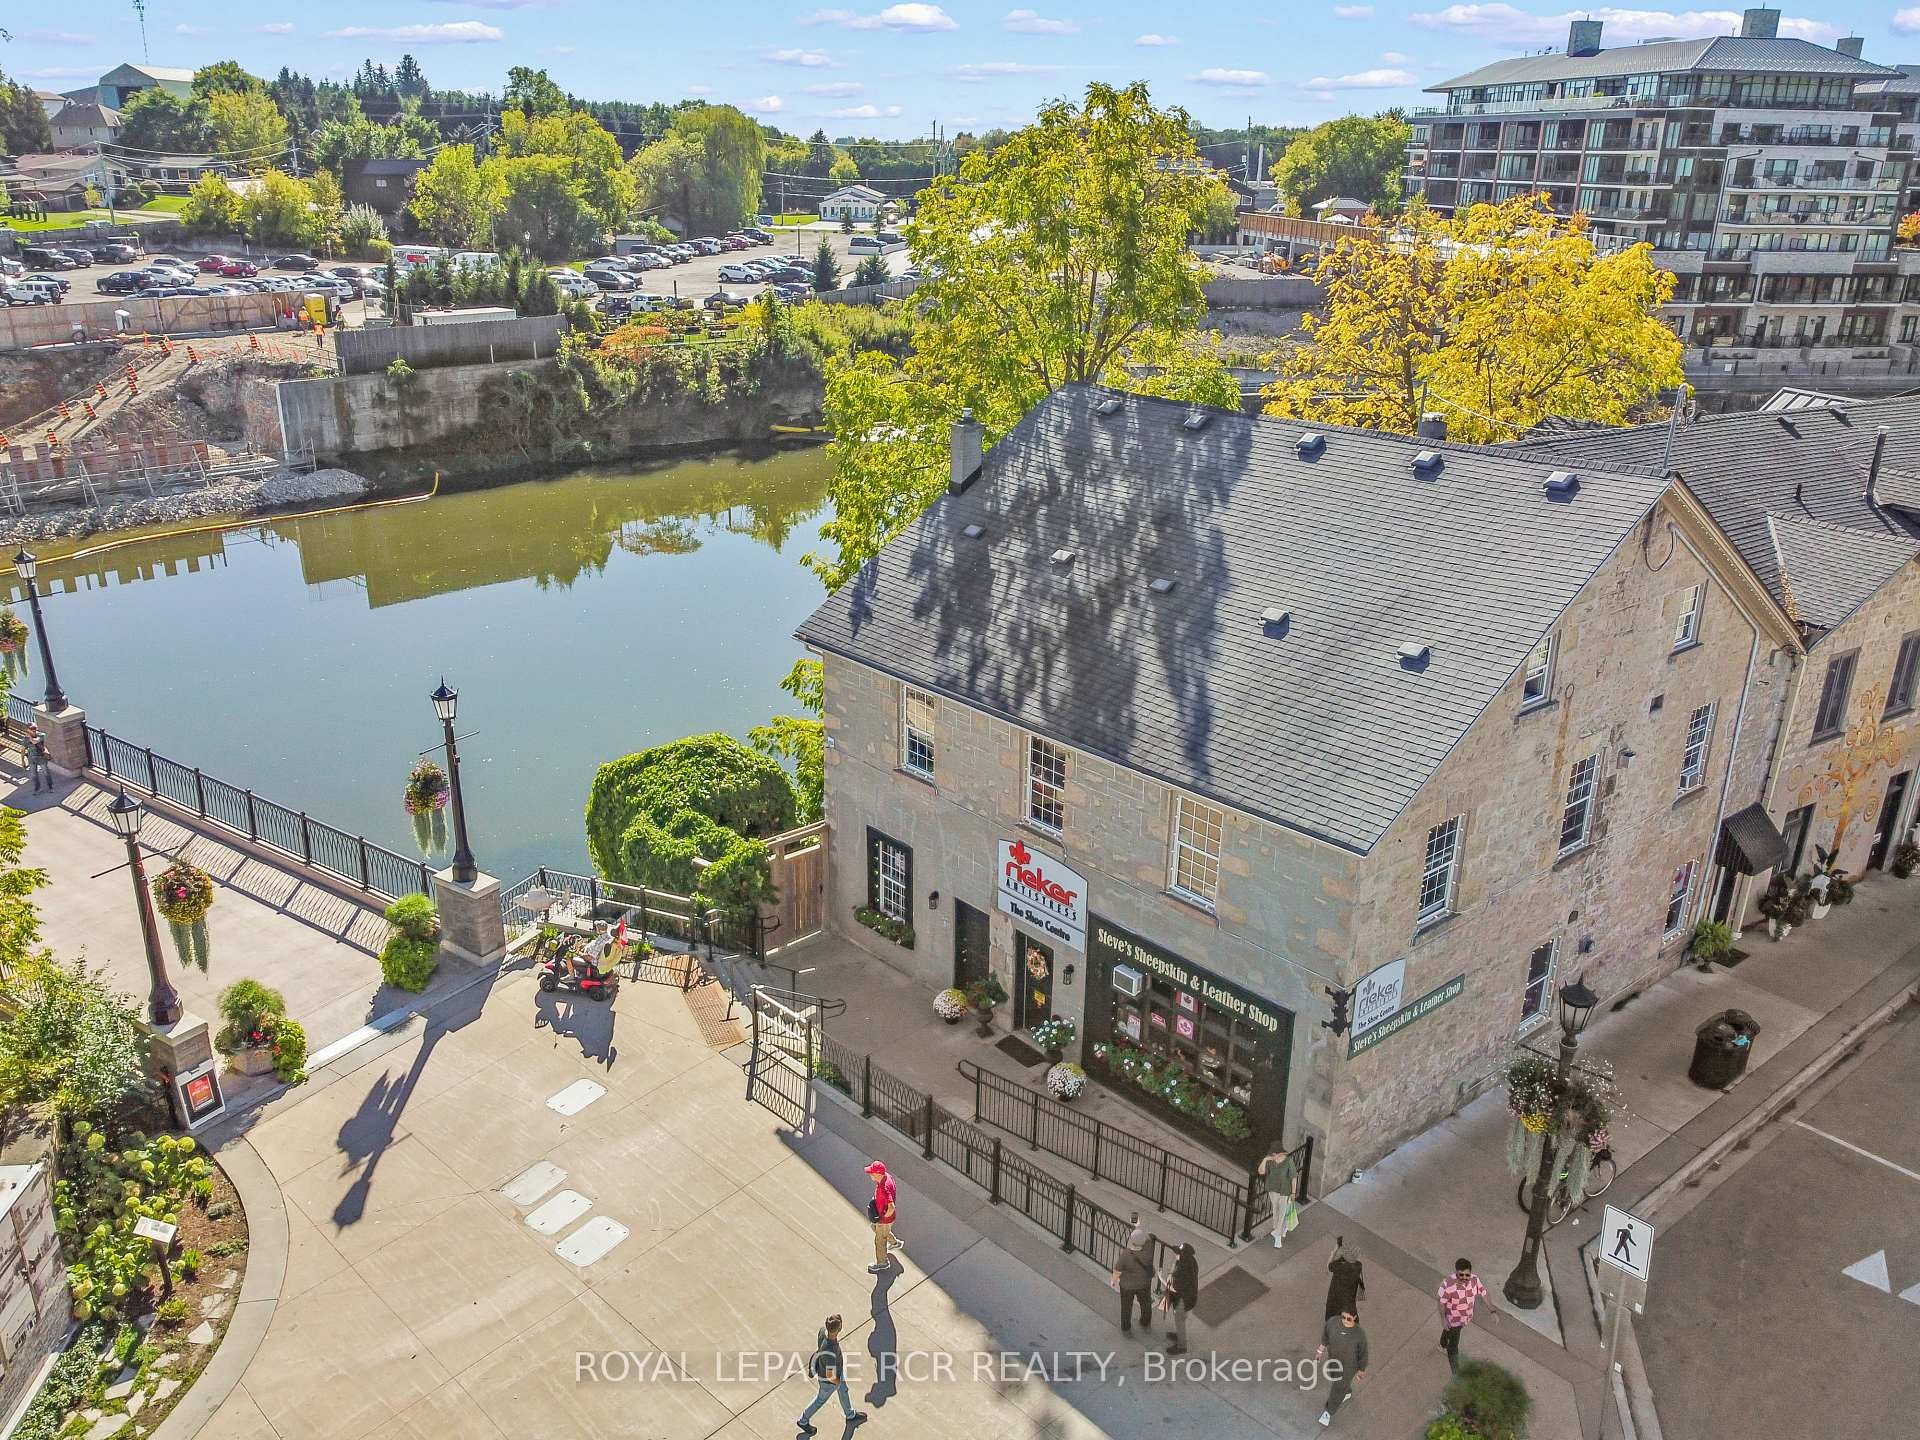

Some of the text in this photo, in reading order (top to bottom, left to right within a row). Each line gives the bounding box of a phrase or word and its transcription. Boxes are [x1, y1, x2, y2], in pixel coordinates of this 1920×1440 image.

[1006, 861, 1077, 906] rieker
[1010, 901, 1071, 941] The Shoe Centre
[1098, 928, 1278, 1033] Steve's Sheepskin & Leather Shop
[1353, 1031, 1378, 1052] Steve's
[1378, 1010, 1412, 1039] Sheepskin
[1413, 1005, 1419, 1017] &
[1420, 992, 1445, 1013] Leather
[1445, 982, 1461, 999] Shop
